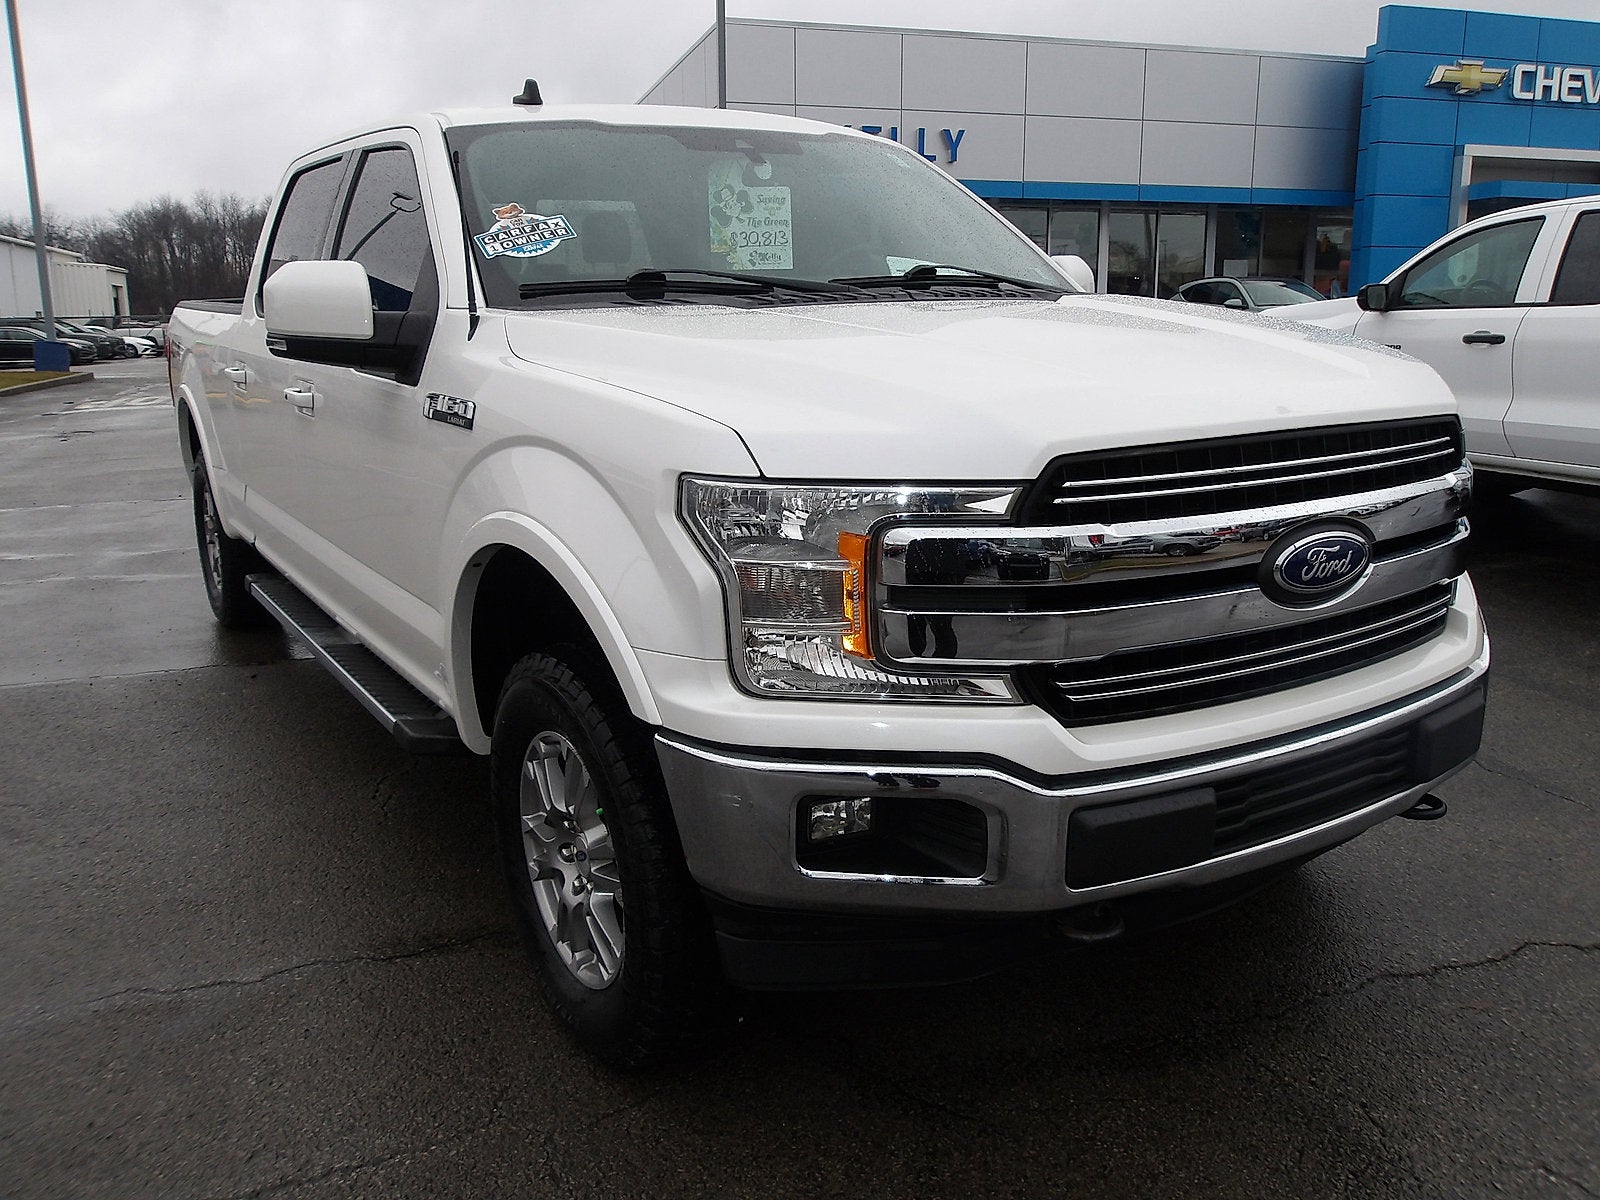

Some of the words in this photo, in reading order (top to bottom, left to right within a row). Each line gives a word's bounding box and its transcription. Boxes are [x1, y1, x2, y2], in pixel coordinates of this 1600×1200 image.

[1511, 63, 1600, 104] CHEV
[483, 220, 561, 244] CARFAX
[747, 216, 762, 228] The
[501, 228, 569, 249] OWNER
[730, 231, 789, 248] $30,813
[1302, 545, 1353, 581] Ford
